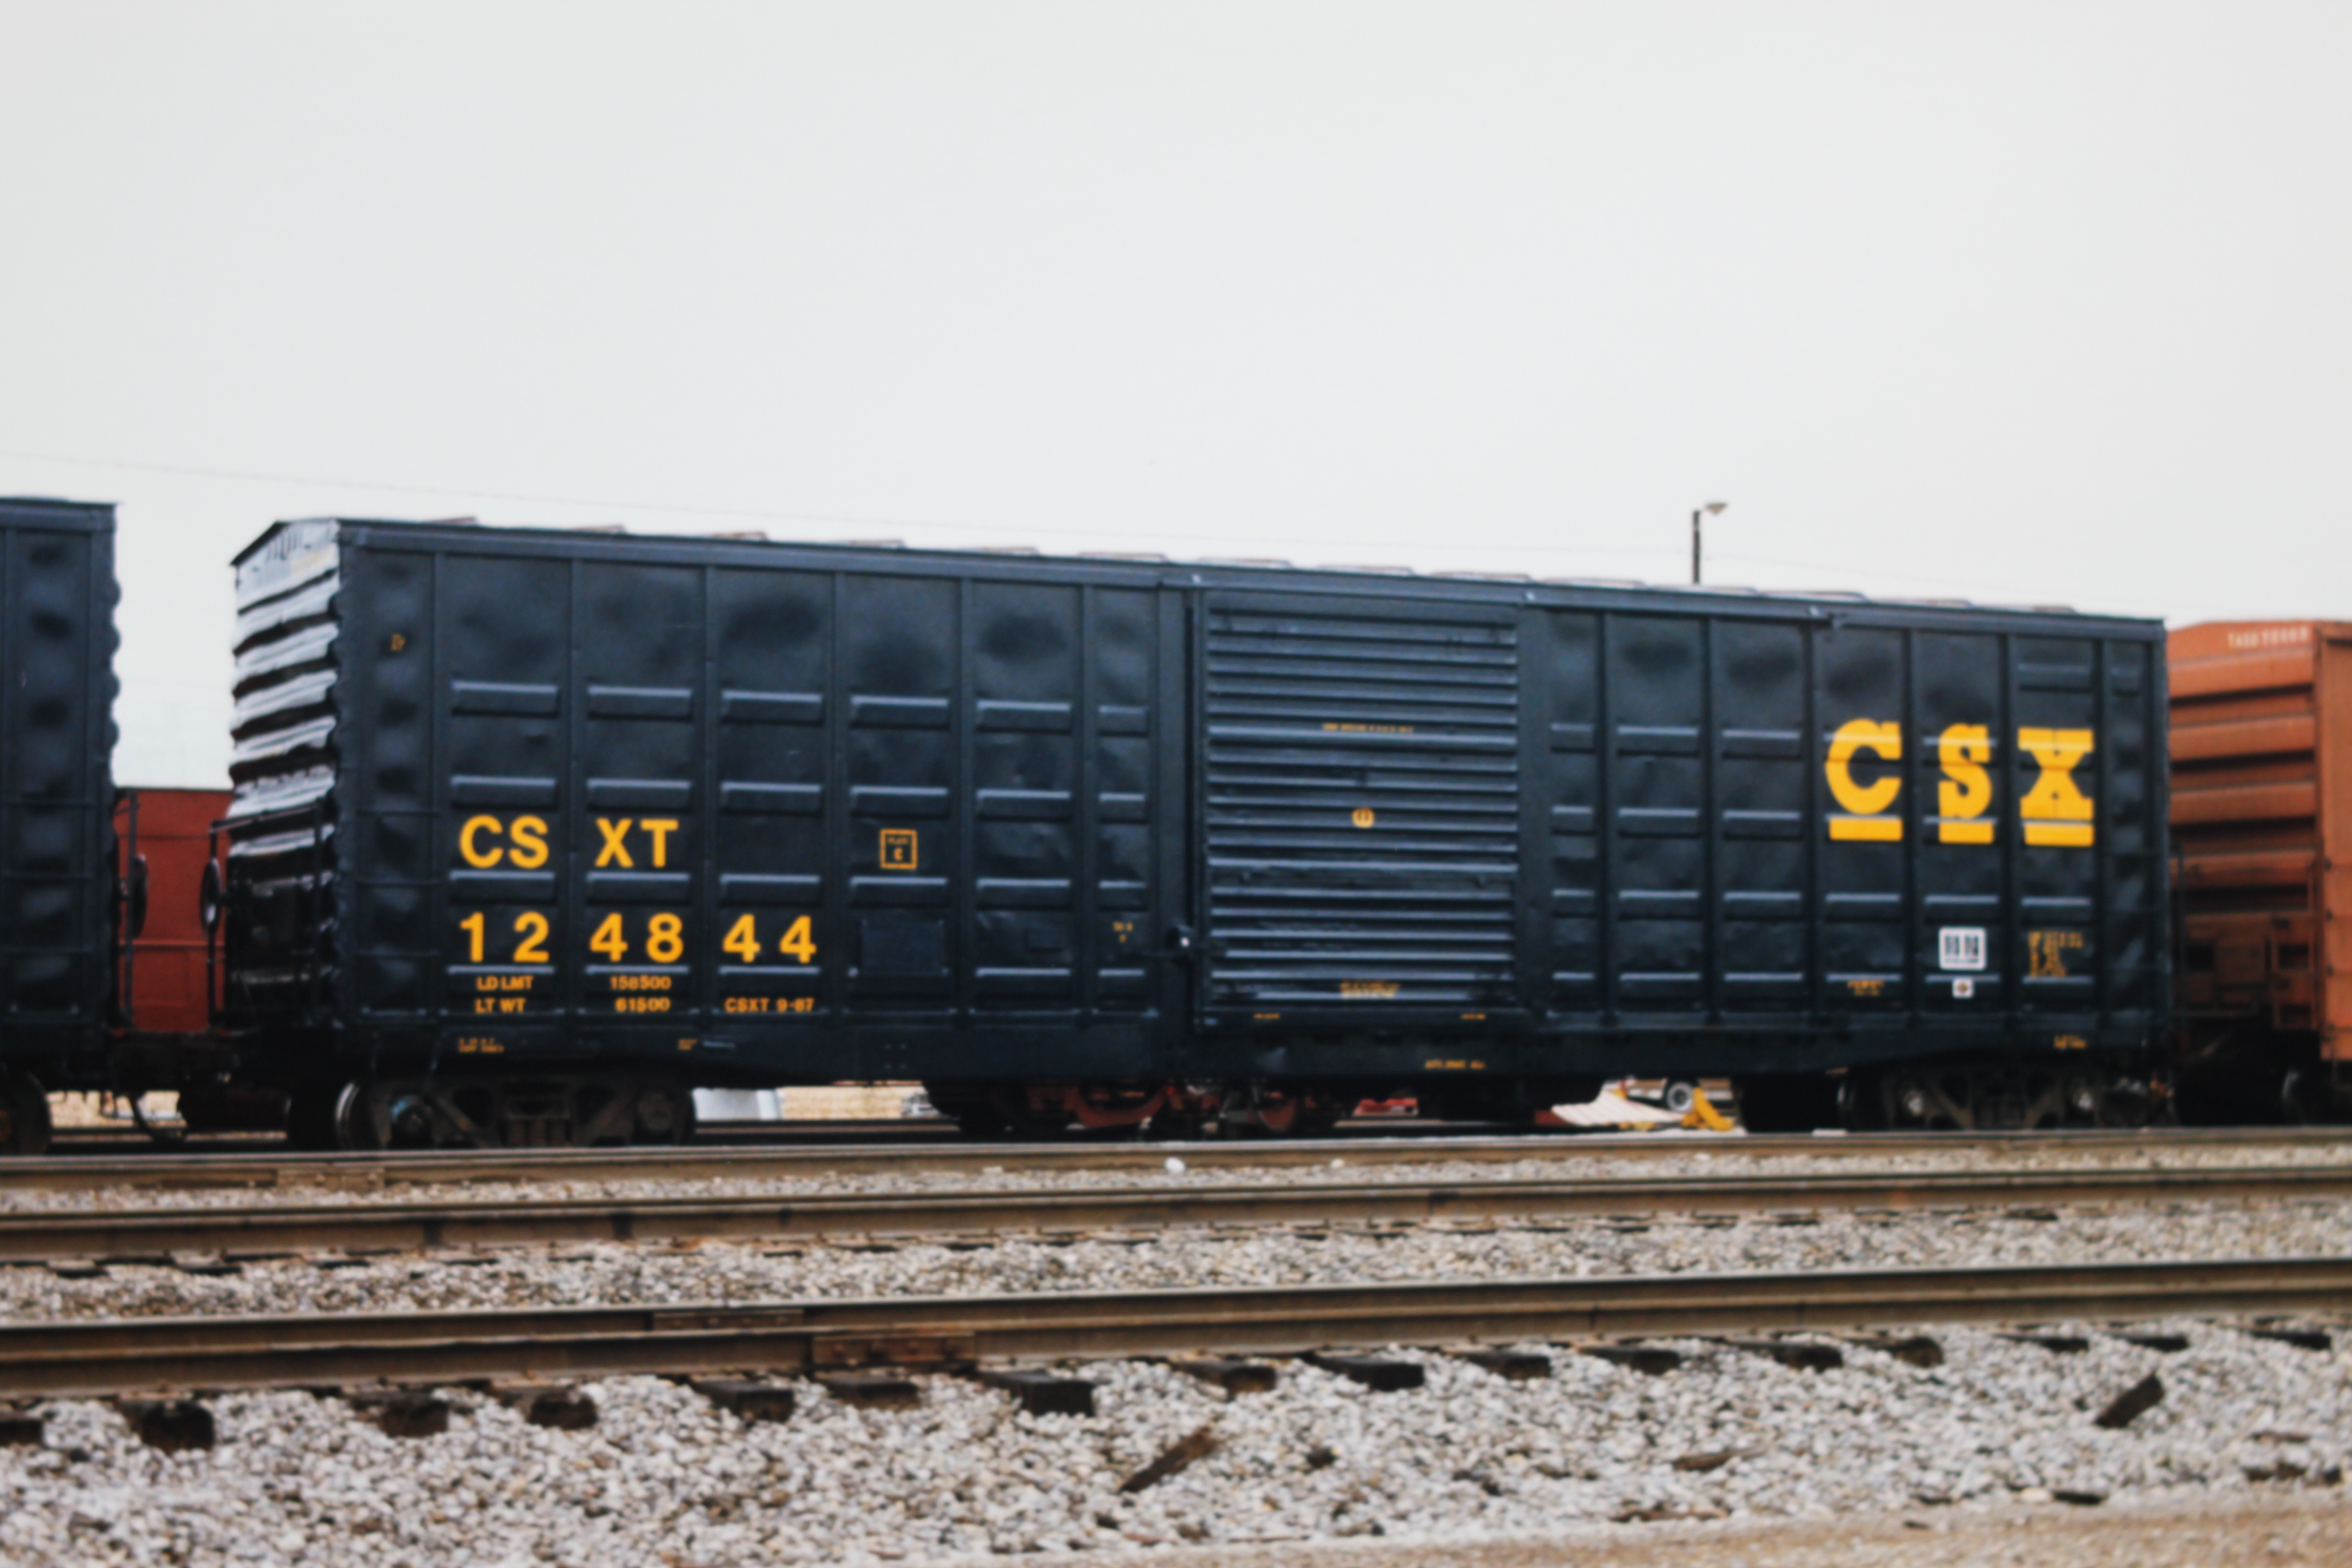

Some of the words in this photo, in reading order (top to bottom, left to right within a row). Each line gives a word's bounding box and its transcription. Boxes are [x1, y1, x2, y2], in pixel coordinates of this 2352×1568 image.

[475, 998, 495, 1013] LT
[500, 997, 526, 1013] WT
[725, 997, 769, 1013] CSXT
